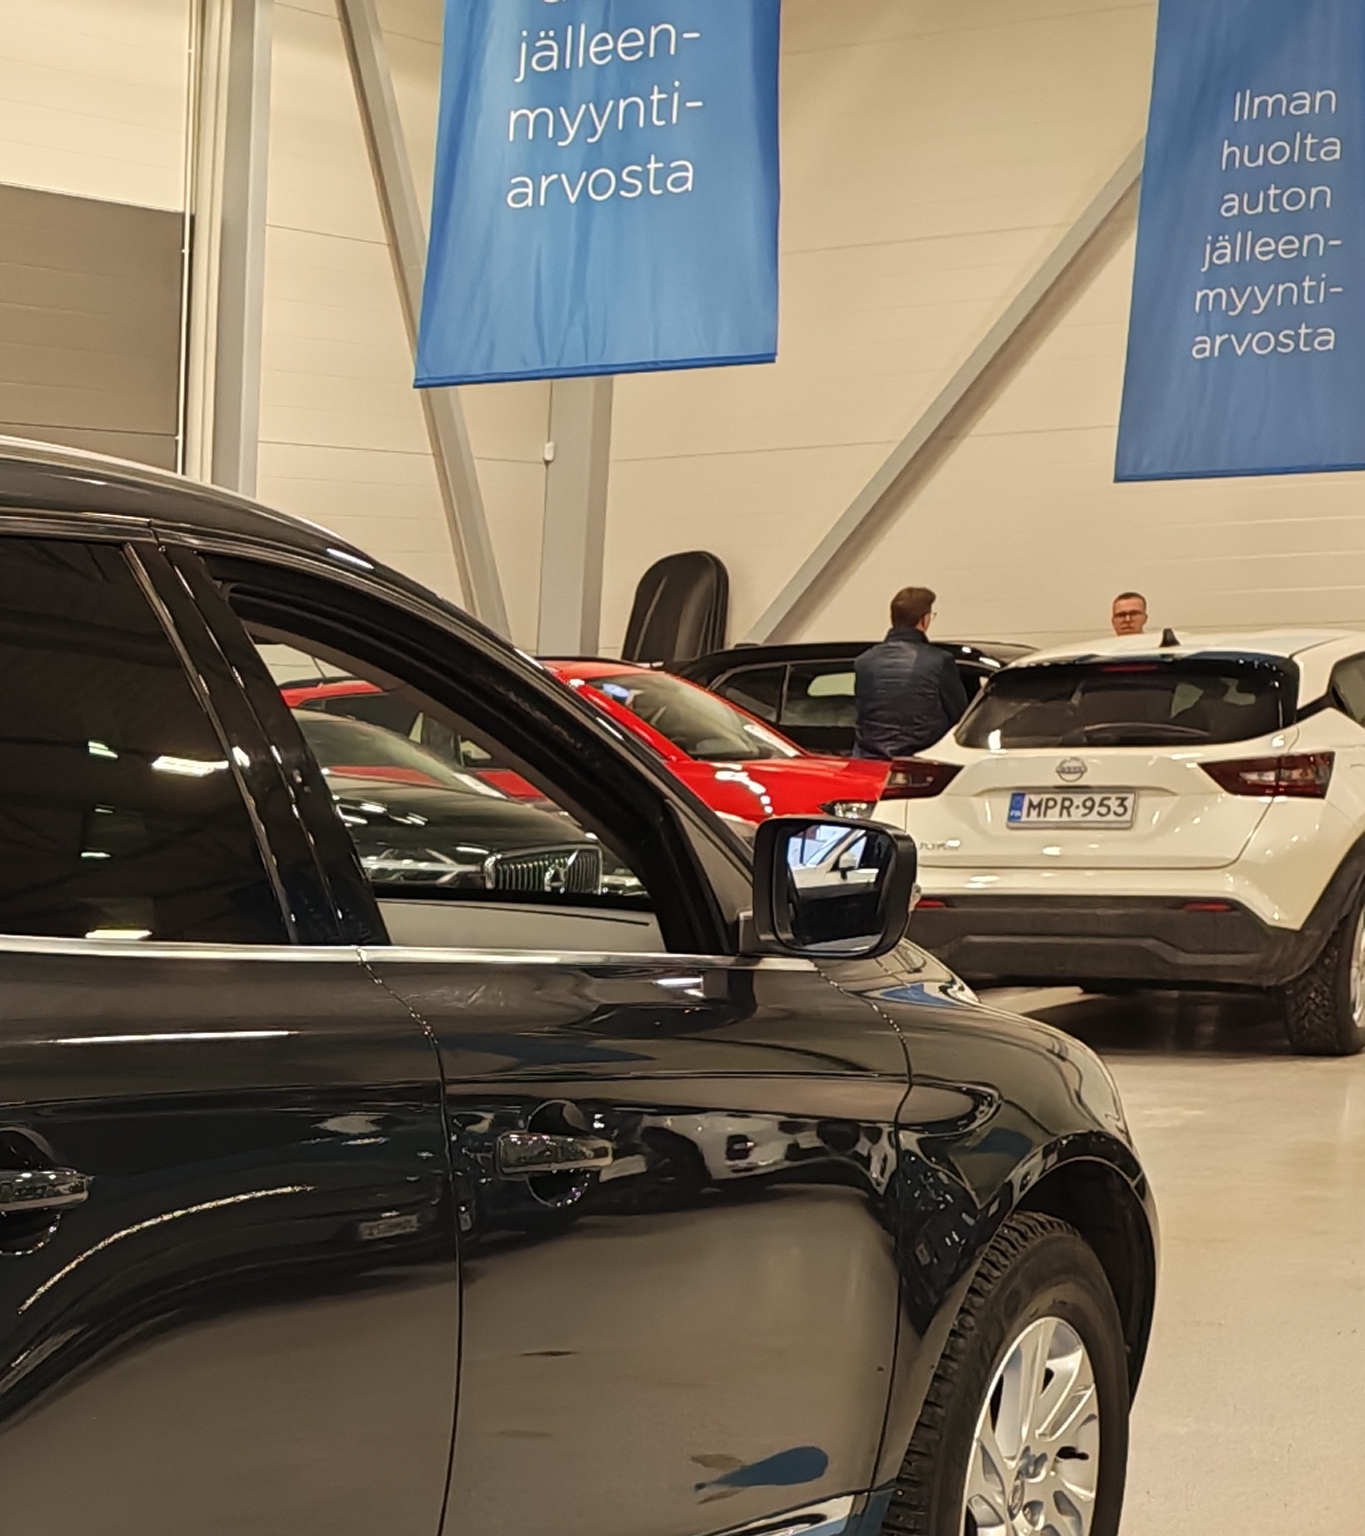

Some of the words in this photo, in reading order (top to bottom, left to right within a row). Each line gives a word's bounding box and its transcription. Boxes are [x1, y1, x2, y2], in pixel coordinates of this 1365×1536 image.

[514, 23, 701, 83] jälleen-
[508, 80, 704, 146] myynti-
[1234, 89, 1337, 122] Ilman
[1221, 131, 1342, 170] huolta
[506, 153, 694, 209] arvosta
[1220, 184, 1332, 217] auton
[1201, 230, 1342, 272] jälleen-
[1195, 273, 1343, 316] myynti-
[1191, 322, 1336, 359] arvosta
[1026, 797, 1129, 818] MPR-953
